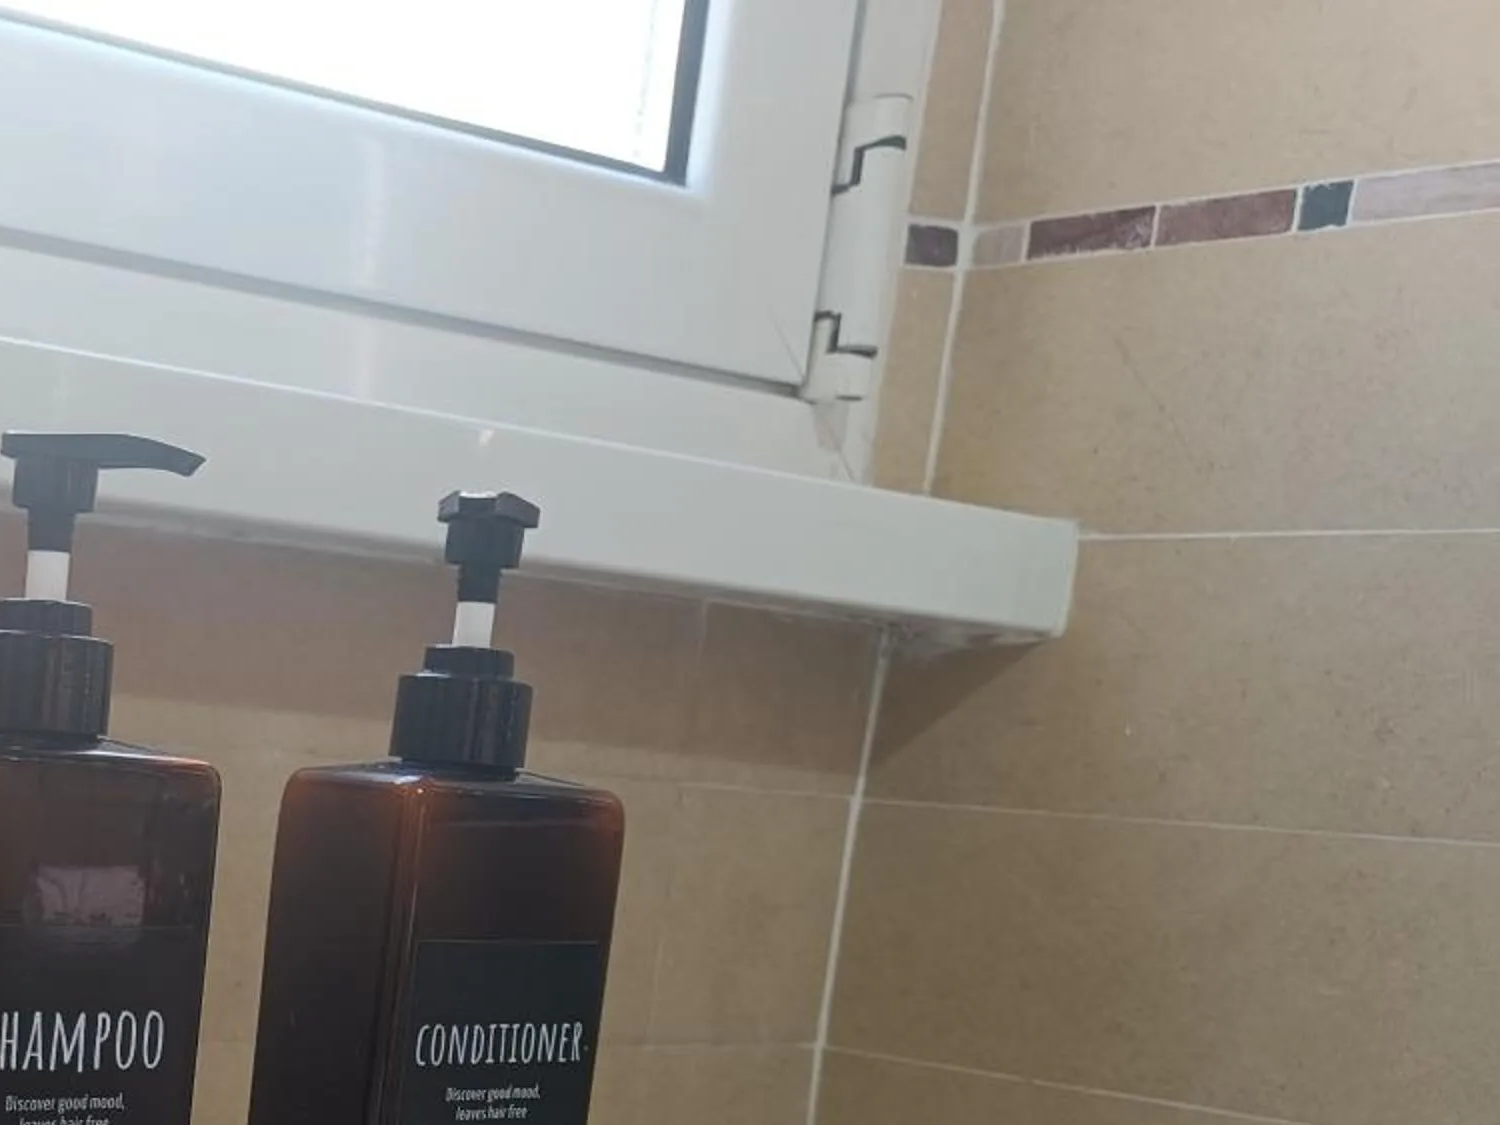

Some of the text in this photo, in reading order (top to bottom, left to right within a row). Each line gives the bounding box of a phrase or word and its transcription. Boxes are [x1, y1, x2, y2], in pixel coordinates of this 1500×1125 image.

[415, 1021, 583, 1067] CONDITIONER
[5, 1092, 125, 1114] Discover good mood,
[446, 1087, 486, 1102] Discover
[487, 1084, 512, 1103] good
[455, 1104, 528, 1121] leaves hair free
